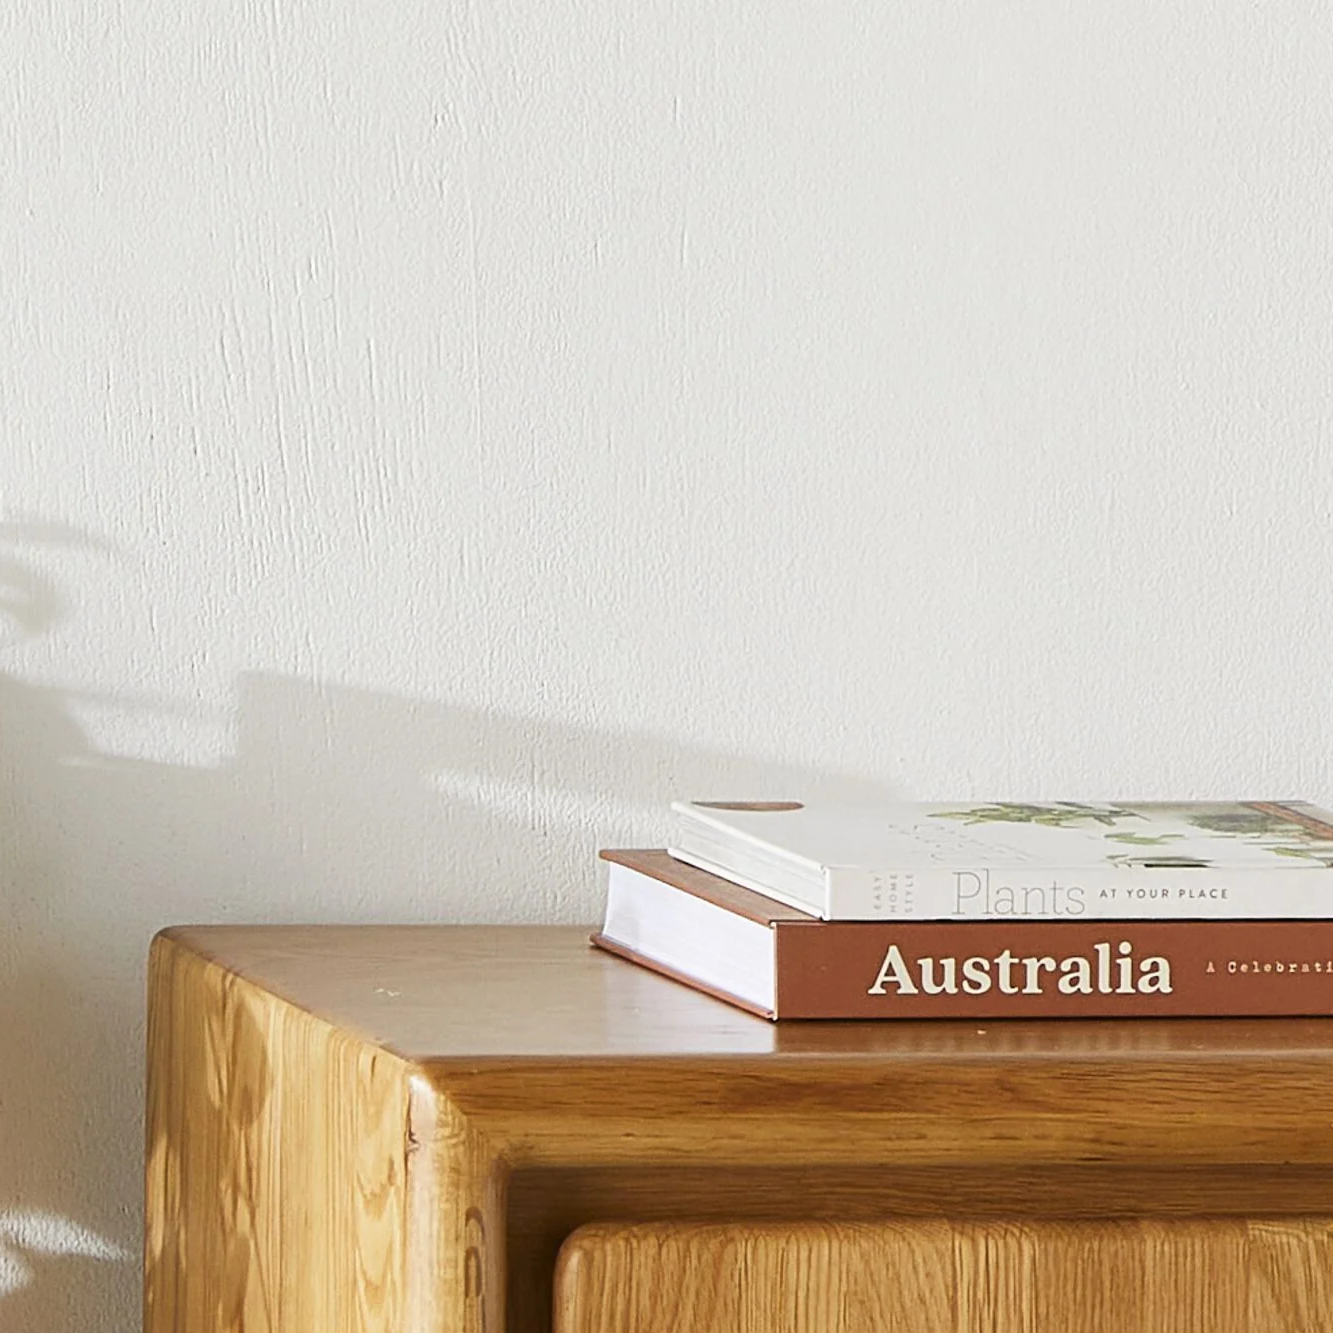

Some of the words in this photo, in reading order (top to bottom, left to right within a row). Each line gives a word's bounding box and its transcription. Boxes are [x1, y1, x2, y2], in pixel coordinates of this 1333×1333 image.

[888, 873, 897, 913] HOME
[904, 873, 914, 913] STYLE
[951, 869, 1085, 916] Plants
[1099, 888, 1117, 899] AT
[1127, 888, 1169, 899] YOUR
[1179, 888, 1229, 899] PLACE
[868, 941, 1173, 994] Australia
[1206, 961, 1215, 973] A
